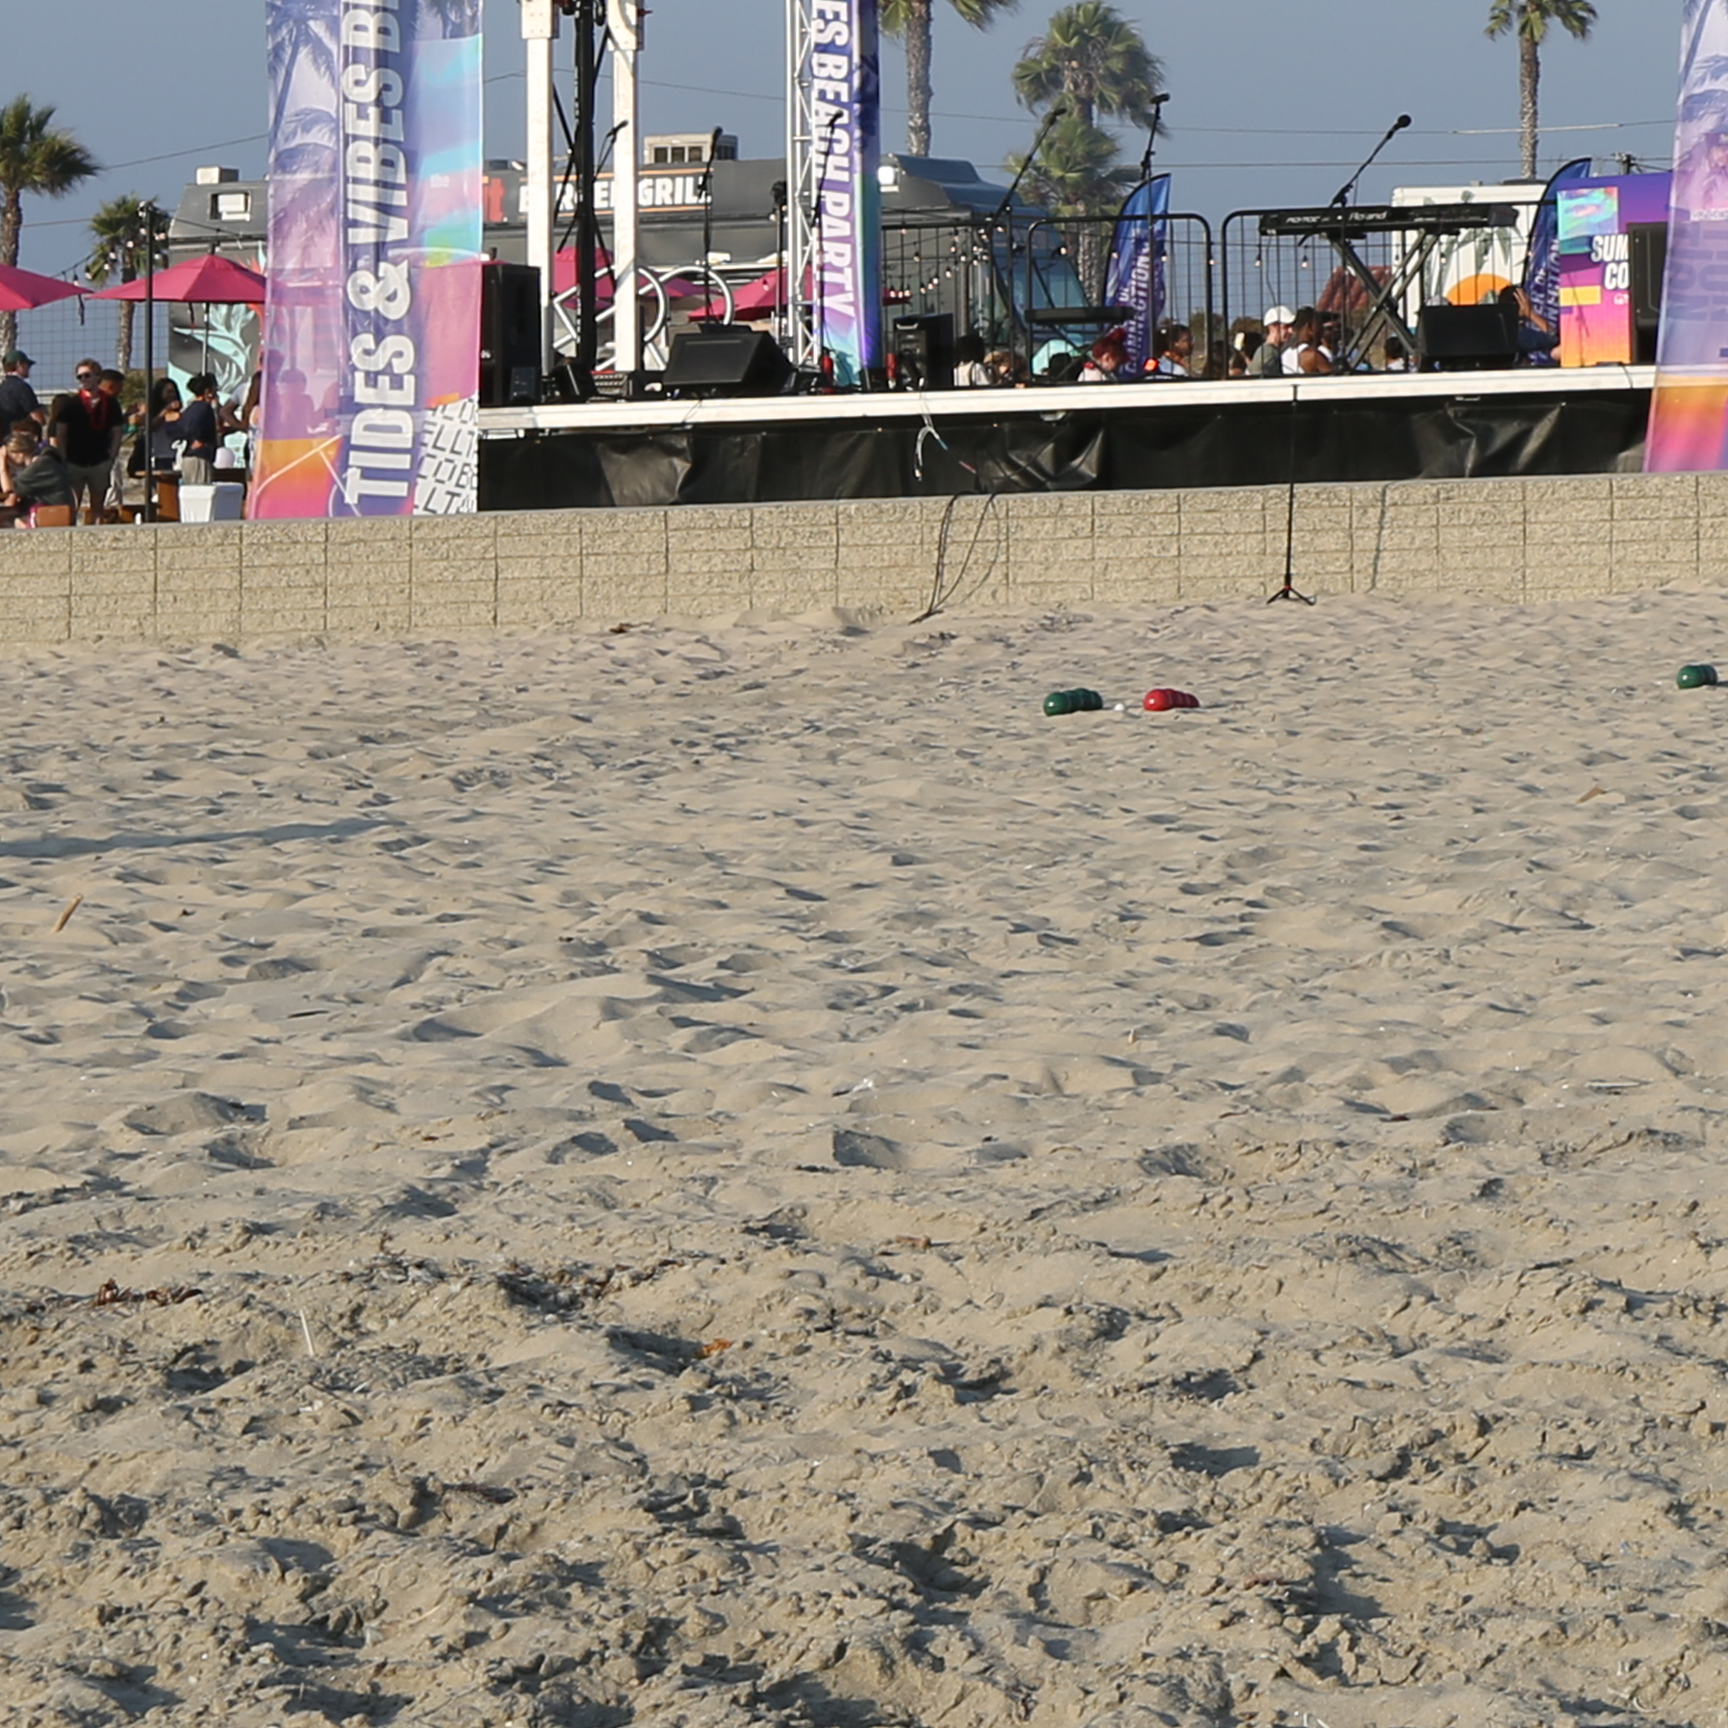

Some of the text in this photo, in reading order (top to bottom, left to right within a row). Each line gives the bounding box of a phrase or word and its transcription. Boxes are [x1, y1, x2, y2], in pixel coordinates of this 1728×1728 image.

[342, 64, 409, 244] VIBES
[811, 52, 851, 183] BEACH
[347, 259, 412, 320] &
[819, 190, 855, 318] PARTY
[344, 330, 416, 504] TIDES
